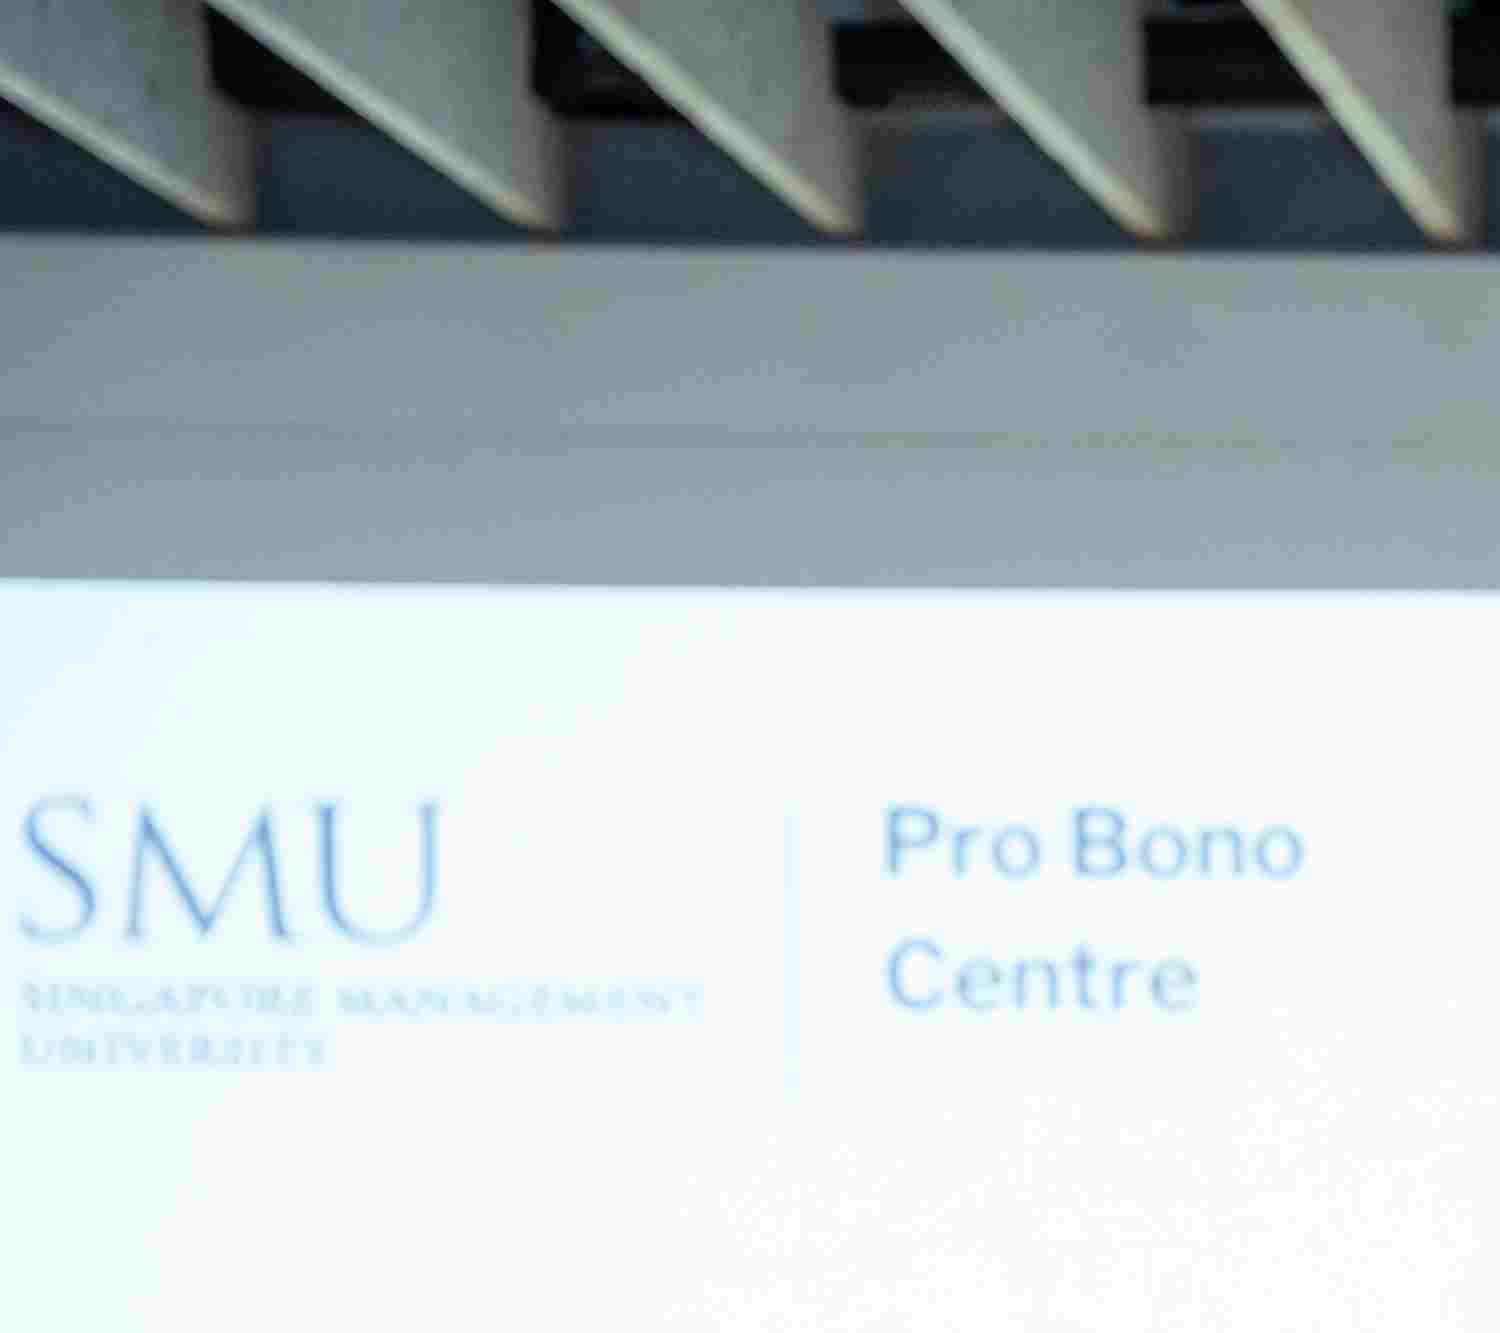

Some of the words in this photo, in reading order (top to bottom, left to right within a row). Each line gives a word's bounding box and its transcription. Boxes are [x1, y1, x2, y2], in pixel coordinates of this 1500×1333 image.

[18, 791, 443, 948] SMU
[881, 803, 1041, 879] Pro
[1072, 803, 1305, 879] Bono
[885, 938, 1199, 1011] Centre
